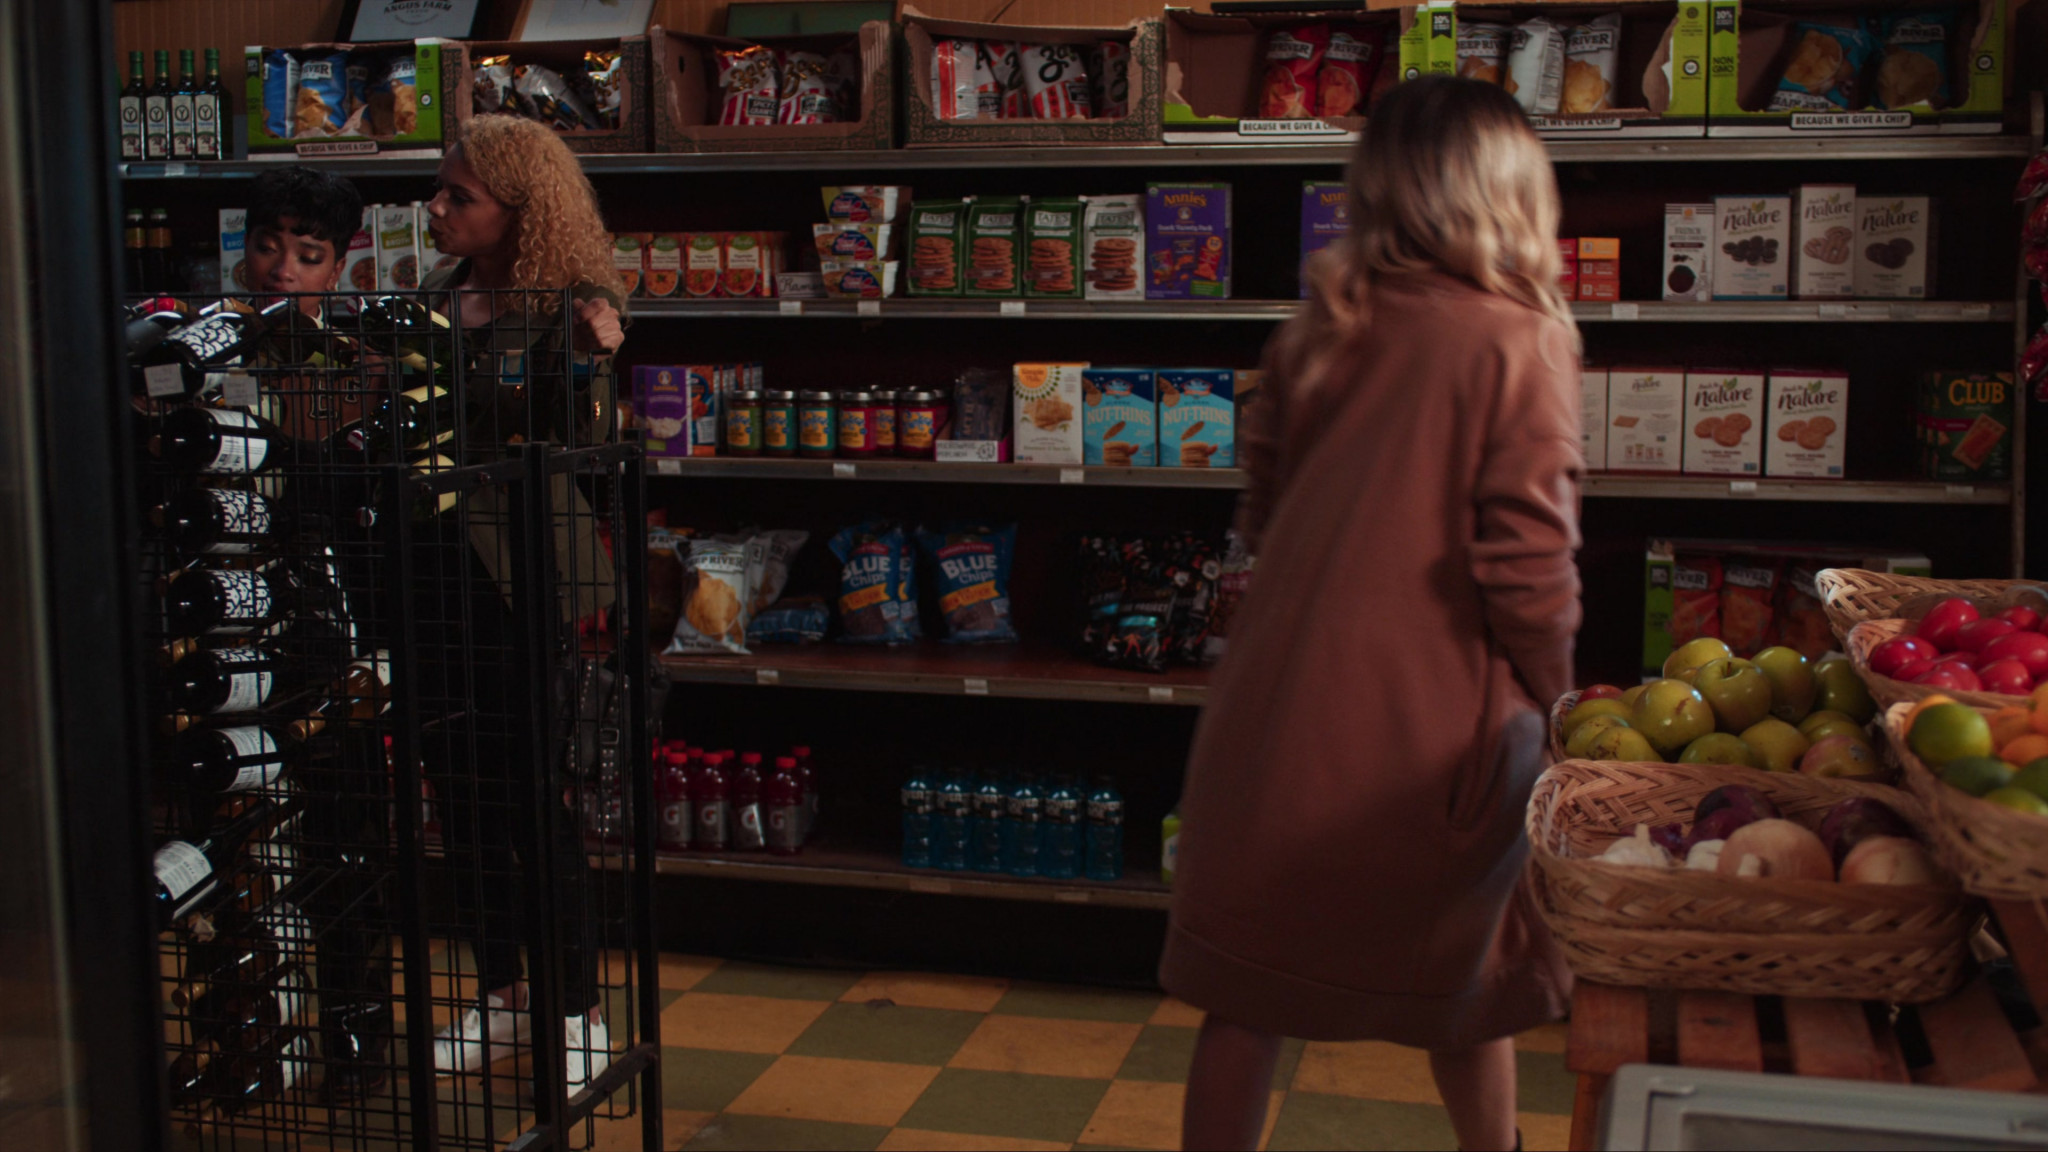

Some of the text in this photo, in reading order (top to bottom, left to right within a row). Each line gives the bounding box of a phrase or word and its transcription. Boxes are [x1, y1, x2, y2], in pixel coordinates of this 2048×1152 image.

[1457, 40, 1480, 49] EEP
[1243, 122, 1273, 131] BECAUSE
[1279, 122, 1292, 130] WE
[1294, 121, 1313, 130] GIVE
[1315, 121, 1321, 130] A
[1550, 118, 1560, 126] WE
[1565, 118, 1585, 126] GIVE
[1588, 118, 1595, 126] A
[1597, 117, 1615, 126] CHIP
[1796, 114, 1905, 125] BECAUSE WE GIVE A CHIP
[1164, 191, 1207, 208] Annie's
[1320, 192, 1346, 205] Ann
[1805, 200, 1853, 219] nature
[1723, 208, 1781, 231] nature
[1862, 208, 1919, 231] nature
[350, 238, 370, 247] ROTH
[1694, 384, 1752, 407] nature
[1778, 387, 1838, 410] nature
[1948, 378, 2006, 406] CLUB
[940, 555, 998, 580] BLUE
[958, 571, 995, 584] Chips
[663, 805, 680, 825] G
[701, 804, 718, 825] G
[770, 809, 785, 830] G
